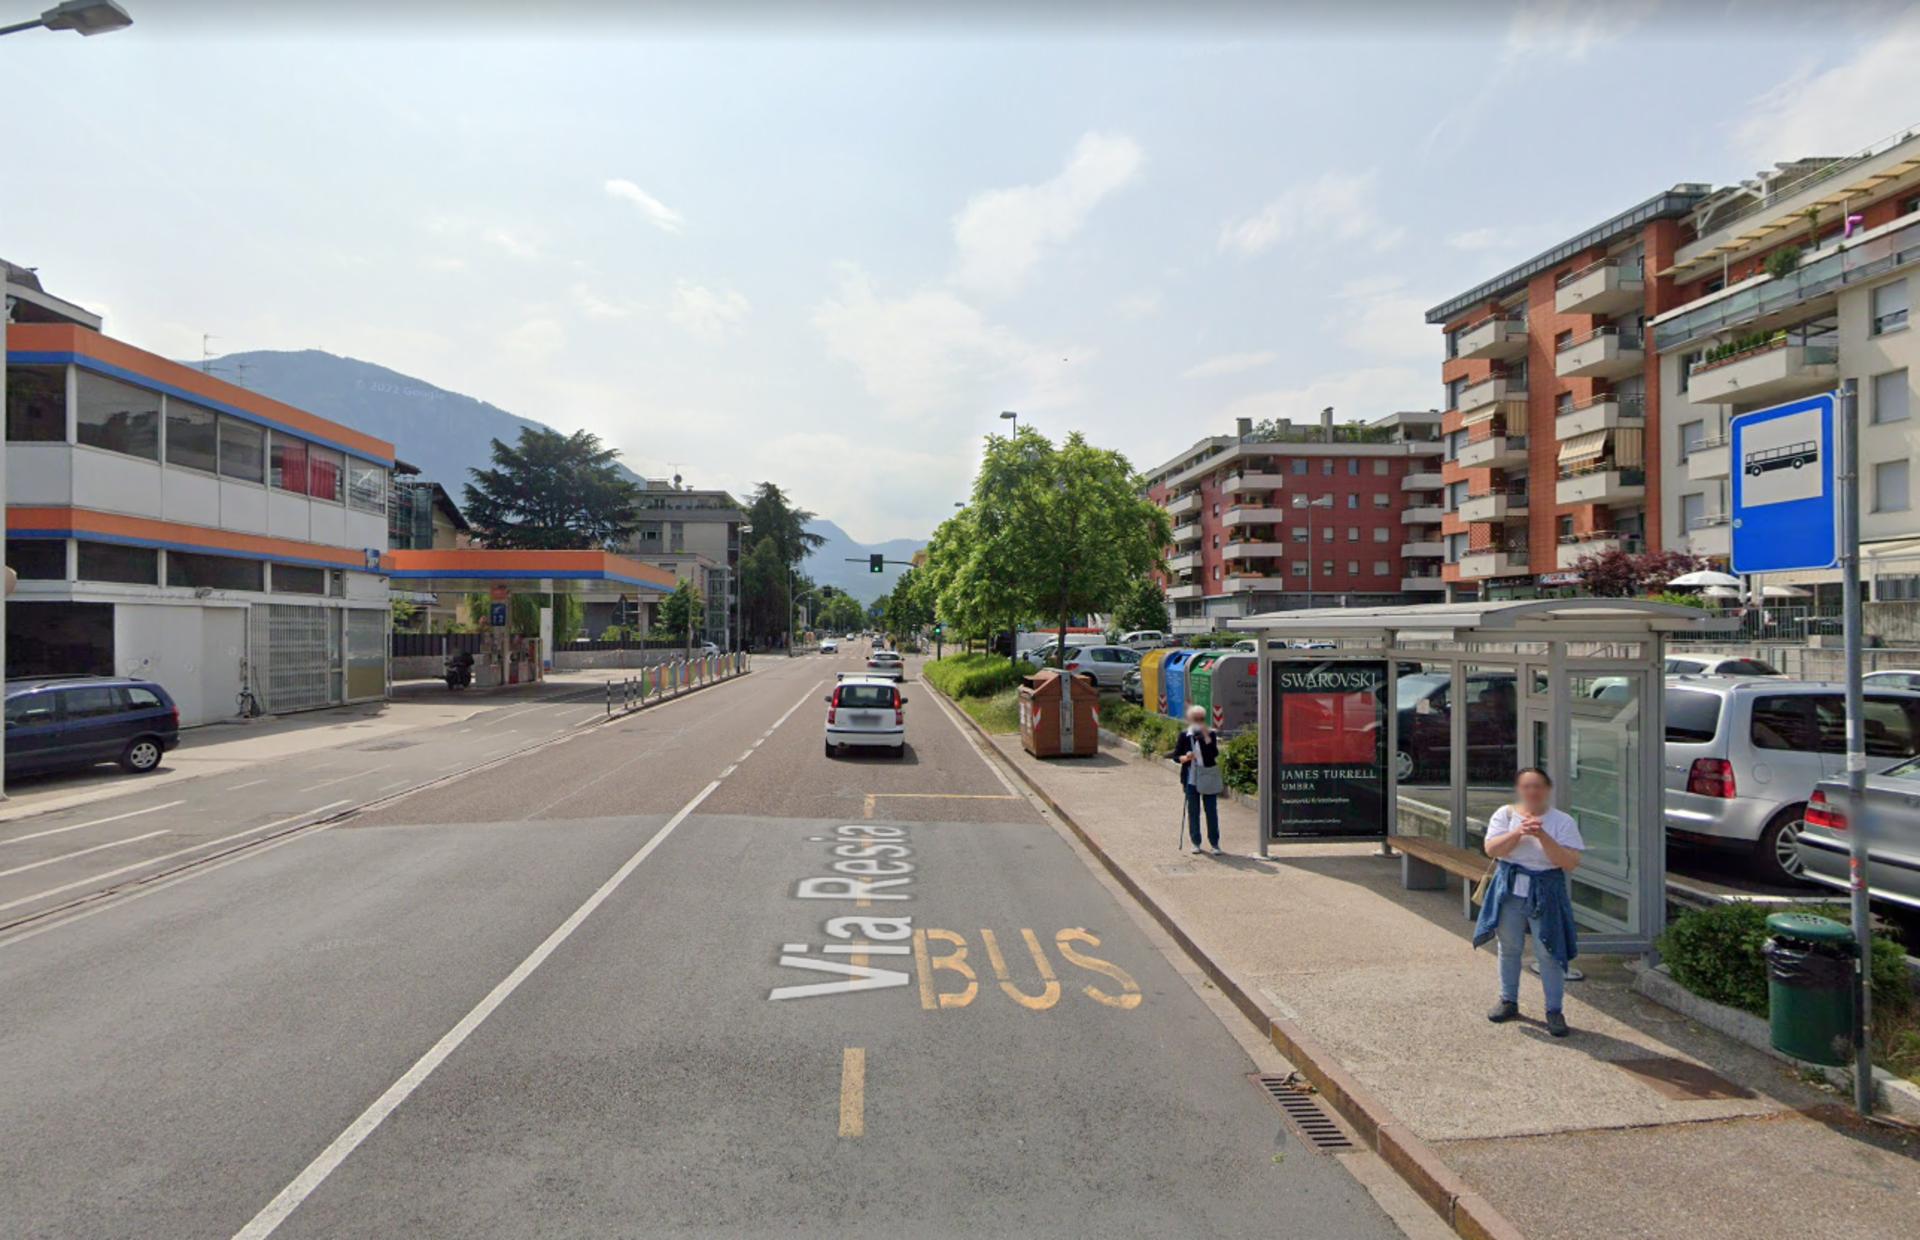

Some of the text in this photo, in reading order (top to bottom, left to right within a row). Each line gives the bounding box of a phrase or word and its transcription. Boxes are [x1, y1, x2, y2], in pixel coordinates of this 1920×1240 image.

[1280, 671, 1376, 688] SWAROVSKI
[1281, 768, 1377, 780] JAMES TURRELL
[1281, 782, 1315, 791] UMBRA
[913, 927, 1143, 1010] BUS
